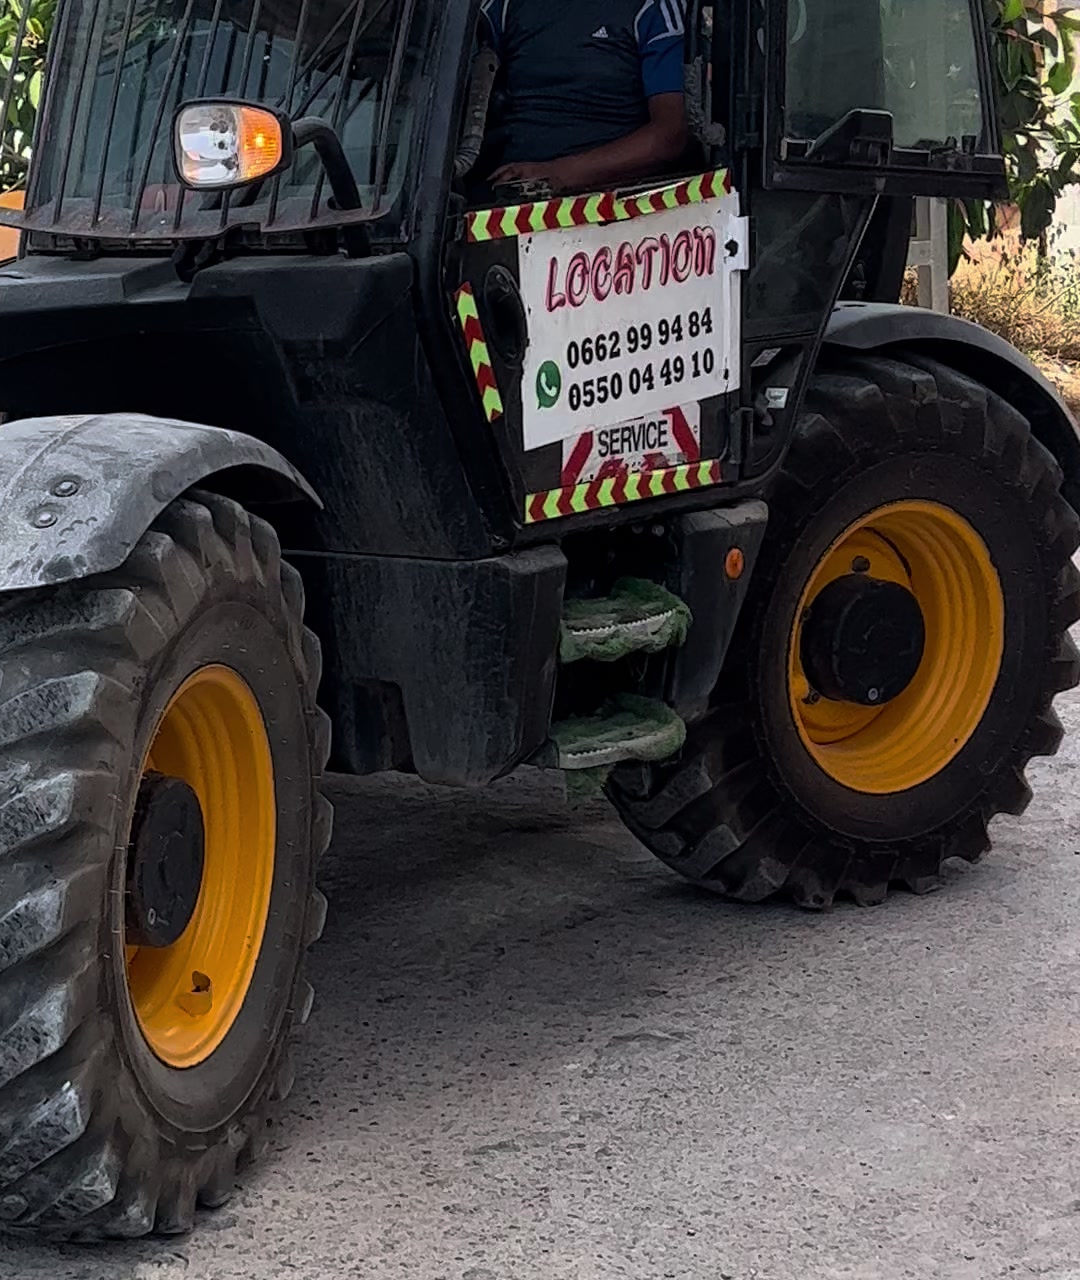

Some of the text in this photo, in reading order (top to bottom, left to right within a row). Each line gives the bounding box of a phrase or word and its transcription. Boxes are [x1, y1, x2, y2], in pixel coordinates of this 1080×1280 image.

[545, 225, 716, 312] LOCATION
[567, 307, 712, 369] 0662 99 94 84
[568, 348, 714, 411] 0550 04 49 10
[598, 420, 668, 457] SERVICE
